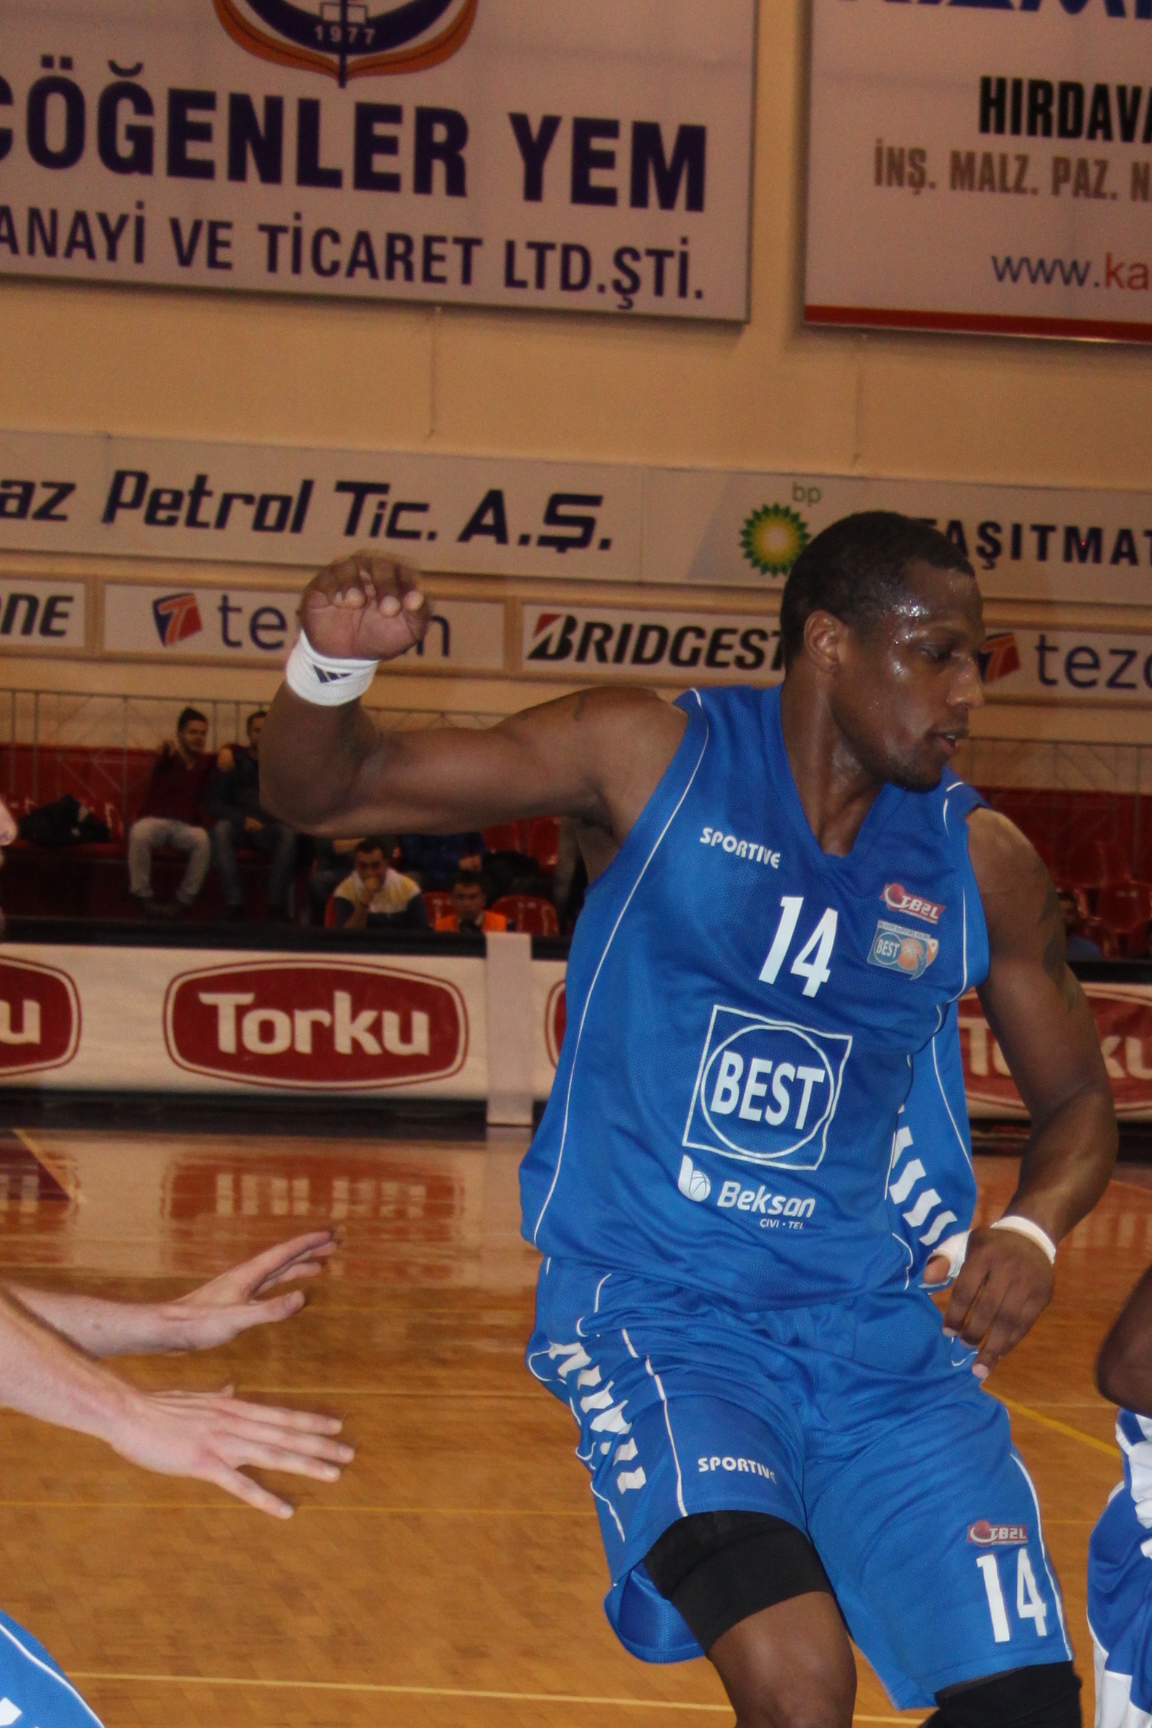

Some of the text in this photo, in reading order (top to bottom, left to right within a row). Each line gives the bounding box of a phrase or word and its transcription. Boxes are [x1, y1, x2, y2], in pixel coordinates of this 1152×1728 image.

[313, 23, 376, 44] 1977
[0, 54, 706, 212] ÖĞENLER YEM
[875, 138, 936, 195] İNŞ.
[950, 149, 1038, 196] MALZ.
[1051, 155, 1117, 200] PAZ.
[169, 217, 233, 270] VE
[258, 212, 483, 285] TİCARET
[102, 470, 315, 533] Petrol
[335, 480, 437, 541] Tic.
[792, 482, 822, 505] bp
[527, 614, 784, 672] BRIDGES
[699, 826, 782, 870] SPORTIVE
[758, 895, 839, 998] 14
[876, 939, 900, 959] BEST
[199, 990, 430, 1056] Torku
[710, 1050, 825, 1130] BEST
[717, 1180, 816, 1218] Beksan
[788, 1221, 804, 1230] TEL
[976, 1548, 1047, 1643] 14
